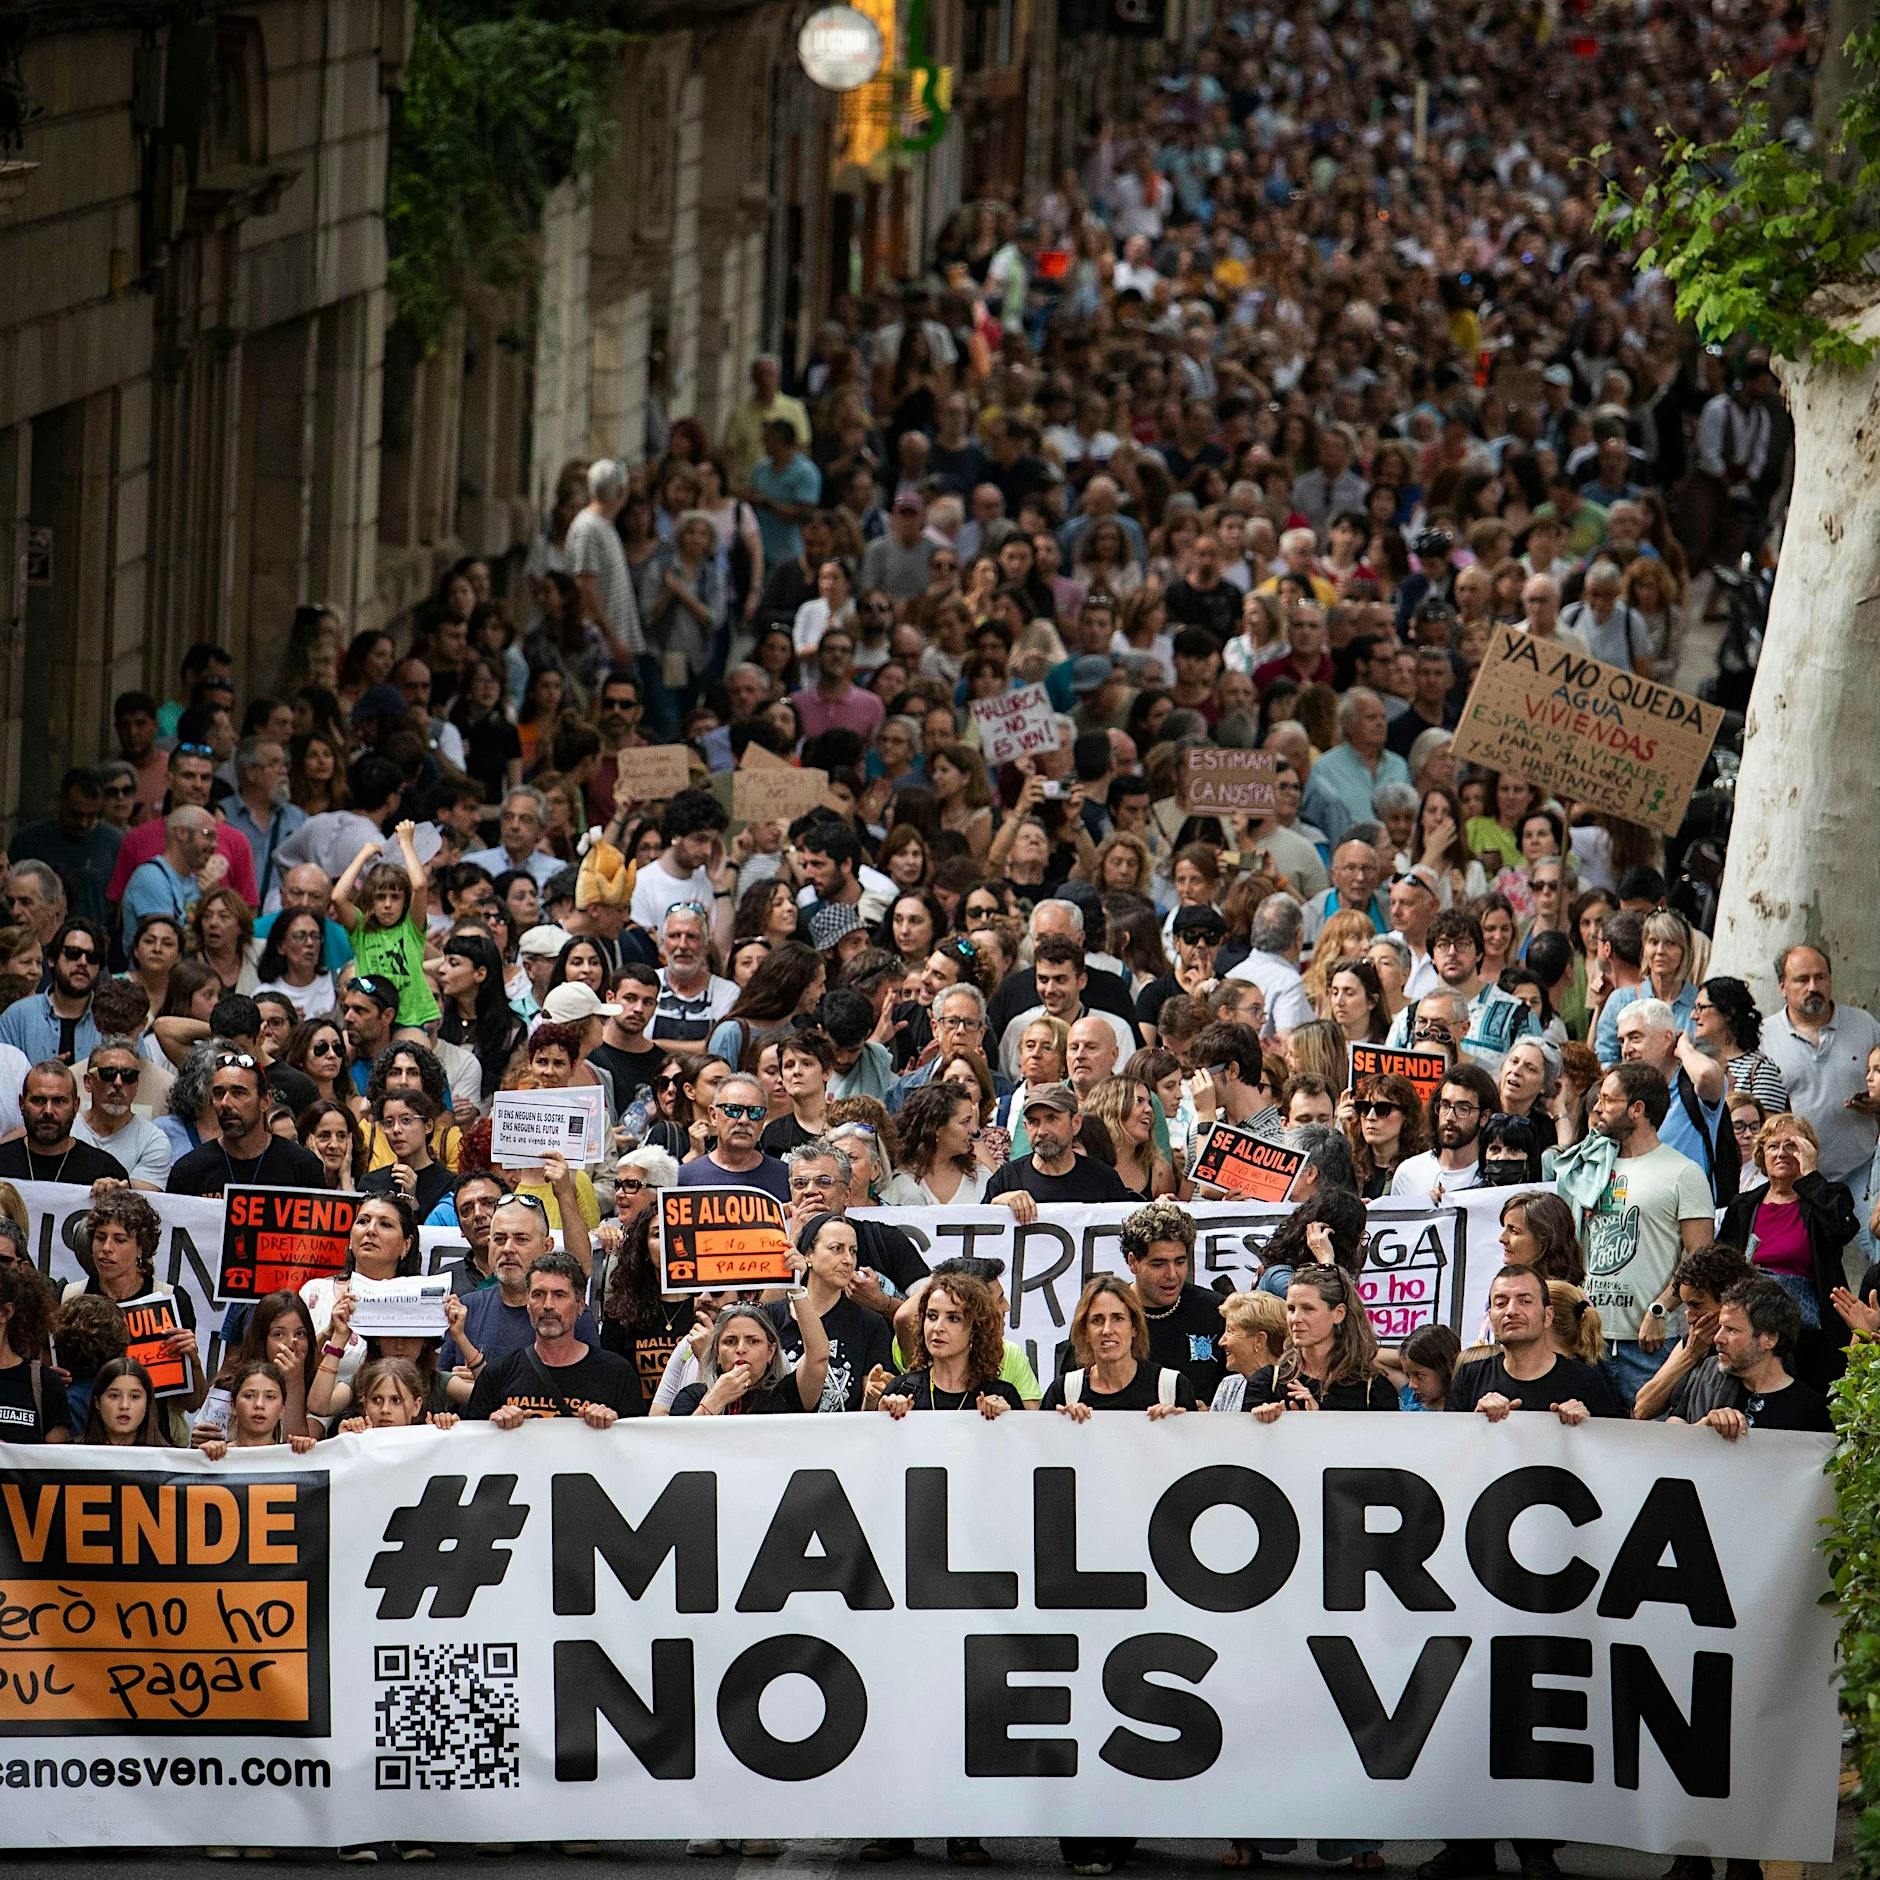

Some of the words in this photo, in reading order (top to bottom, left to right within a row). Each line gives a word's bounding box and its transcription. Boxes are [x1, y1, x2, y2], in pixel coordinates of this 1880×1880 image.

[1501, 633, 1540, 673] YA
[1548, 652, 1601, 690] NO
[1608, 674, 1703, 735] QUEDA
[973, 689, 1047, 722] MALLORCA
[1552, 684, 1624, 726] AGUA
[1525, 694, 1659, 763] VIVIENDAS
[993, 737, 1014, 757] ES
[1472, 704, 1578, 748] ESPACIOS
[1590, 746, 1671, 788] VITALES
[1499, 732, 1544, 755] PARA
[1555, 749, 1634, 790] MALLORCA
[1189, 777, 1217, 803] CA
[1521, 755, 1630, 810] HABITANTES
[1353, 1050, 1377, 1074] SE
[1380, 1053, 1444, 1079] VENDE
[498, 1109, 503, 1118] SI
[504, 1110, 515, 1120] ENS
[515, 1111, 536, 1122] NEGUEN
[536, 1112, 543, 1122] EL
[502, 1122, 513, 1131] ENS
[514, 1122, 535, 1133] NEGUEN
[535, 1124, 541, 1134] EL
[542, 1125, 559, 1135] FUTUR
[500, 1133, 512, 1143] Dret
[547, 1137, 561, 1148] digna
[1211, 1130, 1235, 1152] SE
[1232, 1138, 1299, 1174] ALQUILA
[230, 1195, 265, 1227] SE
[274, 1197, 360, 1234] VEND
[666, 1197, 693, 1226] SE
[698, 1195, 784, 1228] ALQUILA
[261, 1236, 294, 1252] DRET
[310, 1240, 339, 1254] UNA
[703, 1238, 713, 1253] I
[726, 1238, 745, 1251] NO
[1368, 1224, 1448, 1268] GA
[716, 1260, 772, 1274] PAGAR
[382, 1295, 419, 1304] FUTURO
[1356, 1282, 1378, 1301] o
[1389, 1274, 1425, 1304] ho
[124, 1306, 175, 1338] UILA
[507, 1396, 590, 1409] MALLCA
[2, 1484, 298, 1565] VENDE
[365, 1465, 1737, 1629] #MALLORCA
[0, 1585, 96, 1641] erò
[116, 1600, 188, 1639] no
[217, 1588, 295, 1642] ho
[108, 1655, 278, 1720] pagar
[554, 1634, 867, 1783] NO
[964, 1634, 1223, 1779] ES
[1307, 1635, 1734, 1800] VEN
[0, 1756, 331, 1788] anoesven.com
